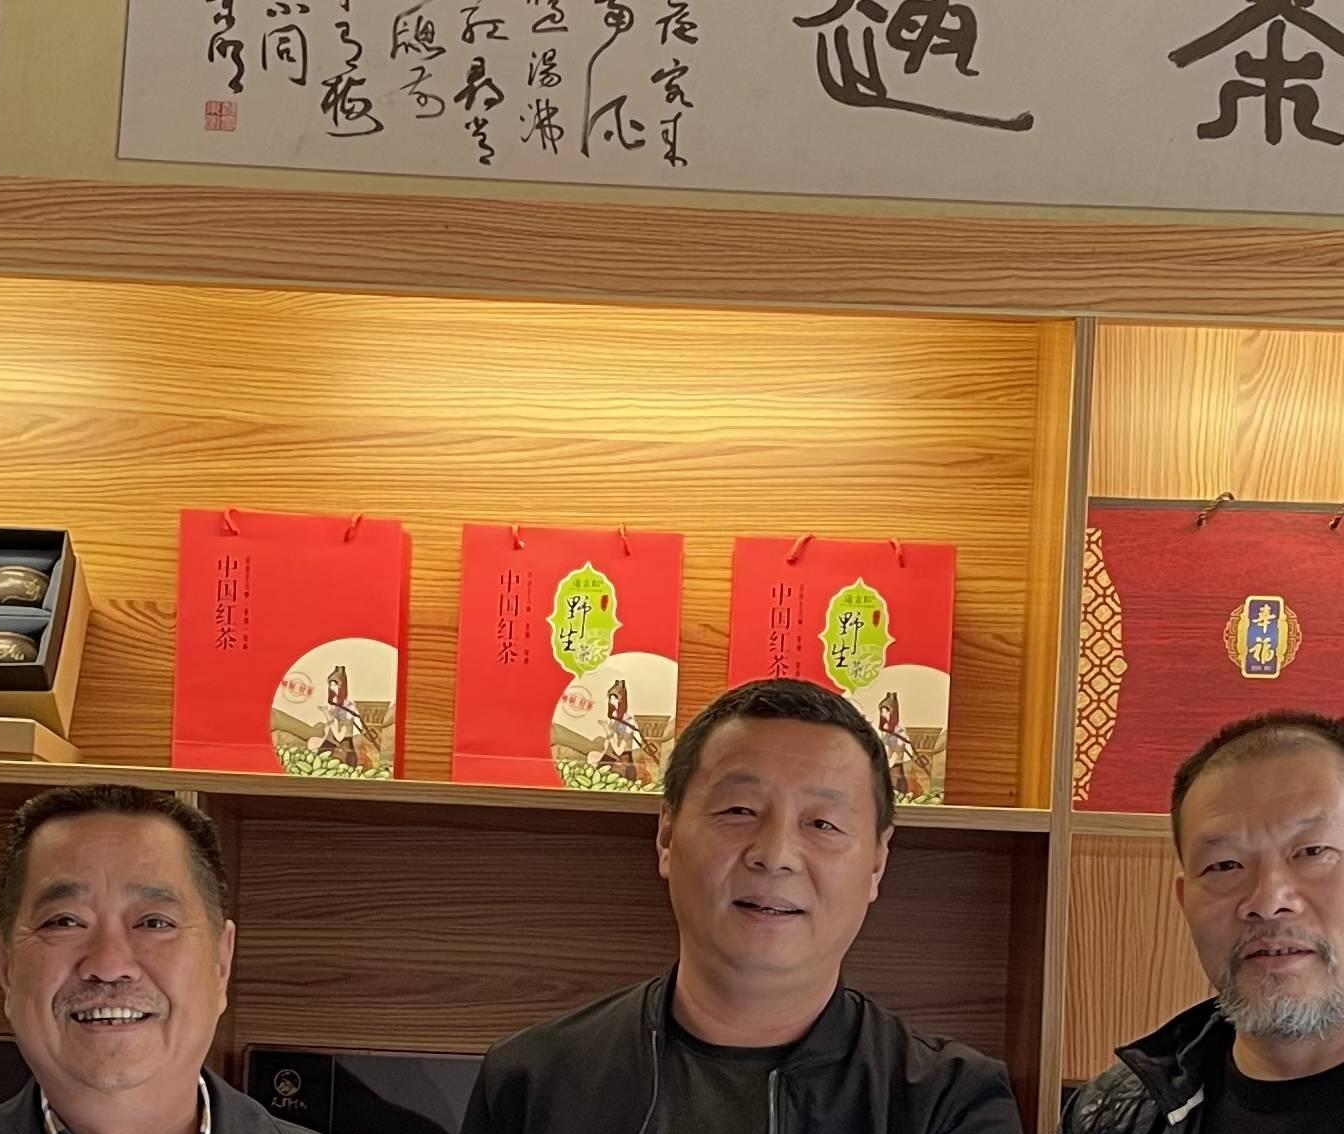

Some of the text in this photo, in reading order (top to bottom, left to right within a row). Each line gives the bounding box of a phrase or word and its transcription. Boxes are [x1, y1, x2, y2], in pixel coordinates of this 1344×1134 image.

[215, 555, 238, 650] 中国红茶
[497, 570, 520, 665] 中国红茶
[768, 582, 792, 679] 中国红茶
[1249, 604, 1276, 665] 幸福
